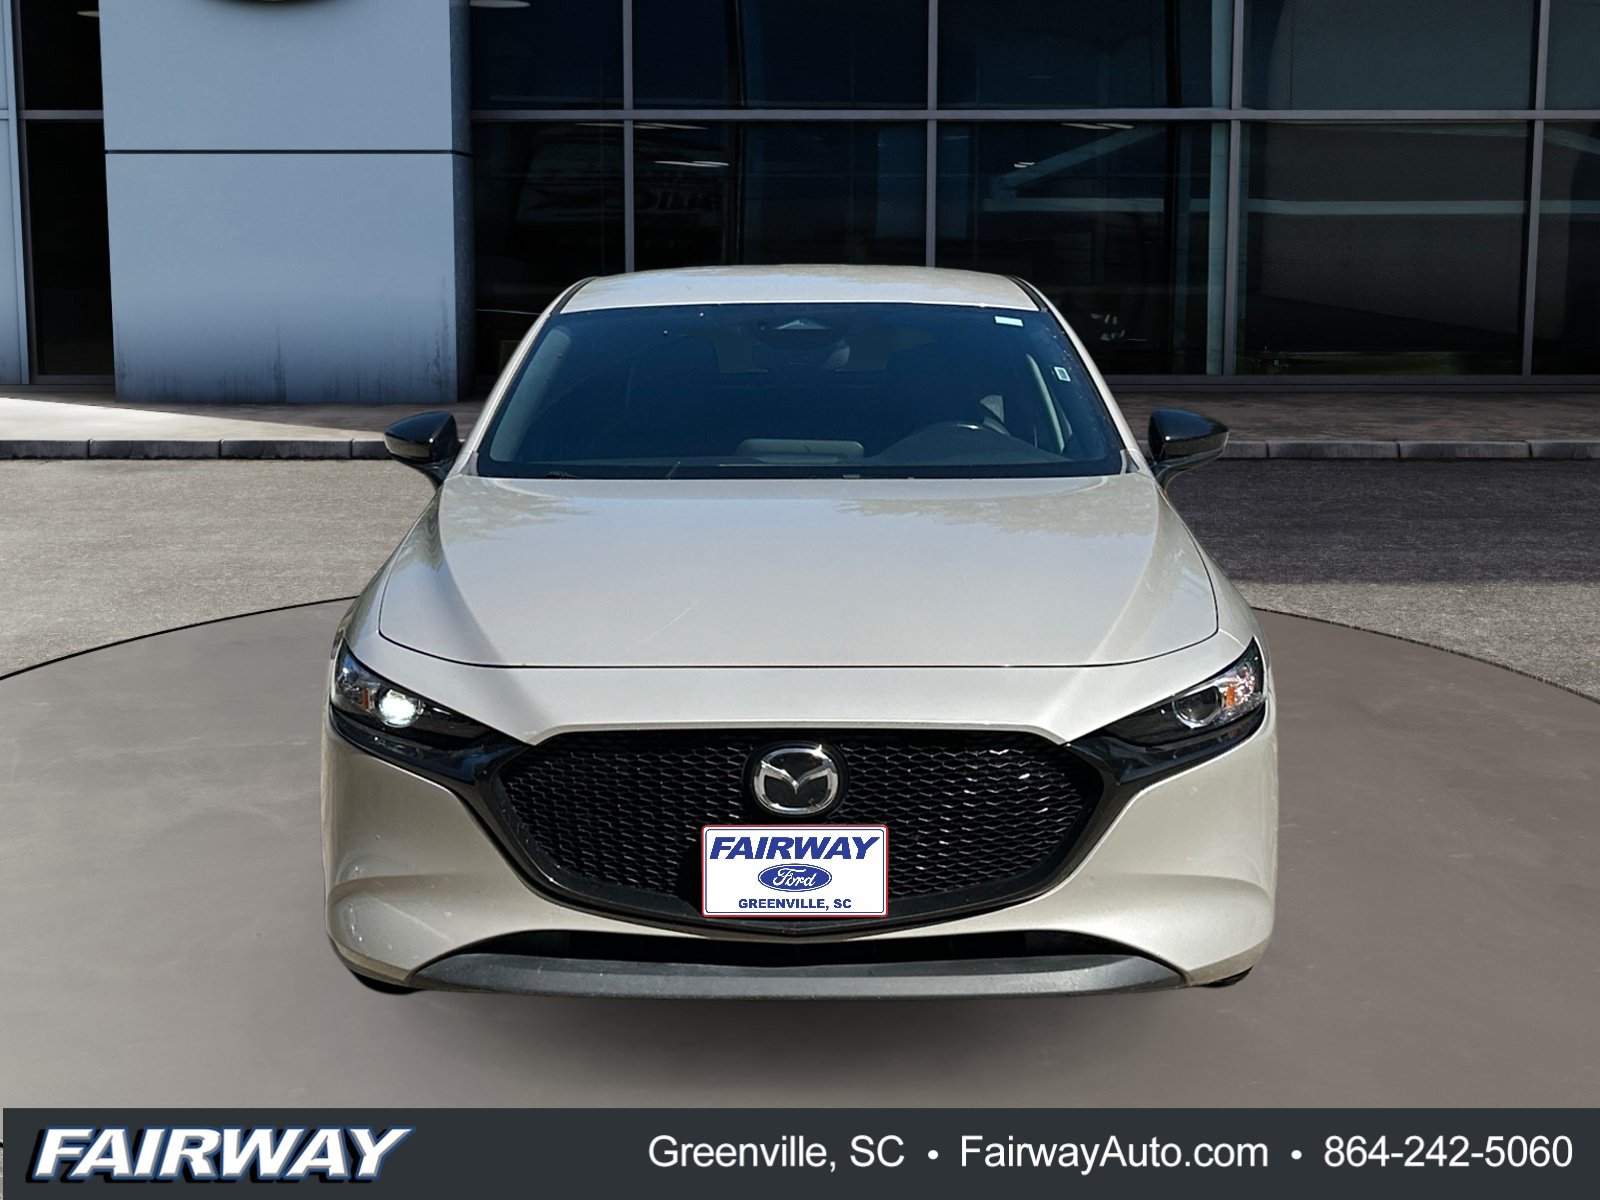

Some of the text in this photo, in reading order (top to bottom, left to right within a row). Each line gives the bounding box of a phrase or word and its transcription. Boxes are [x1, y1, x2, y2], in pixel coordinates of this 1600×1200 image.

[709, 836, 880, 860] FAIRWAY
[772, 867, 817, 887] Ford
[738, 898, 852, 911] GREENVILLE, SC
